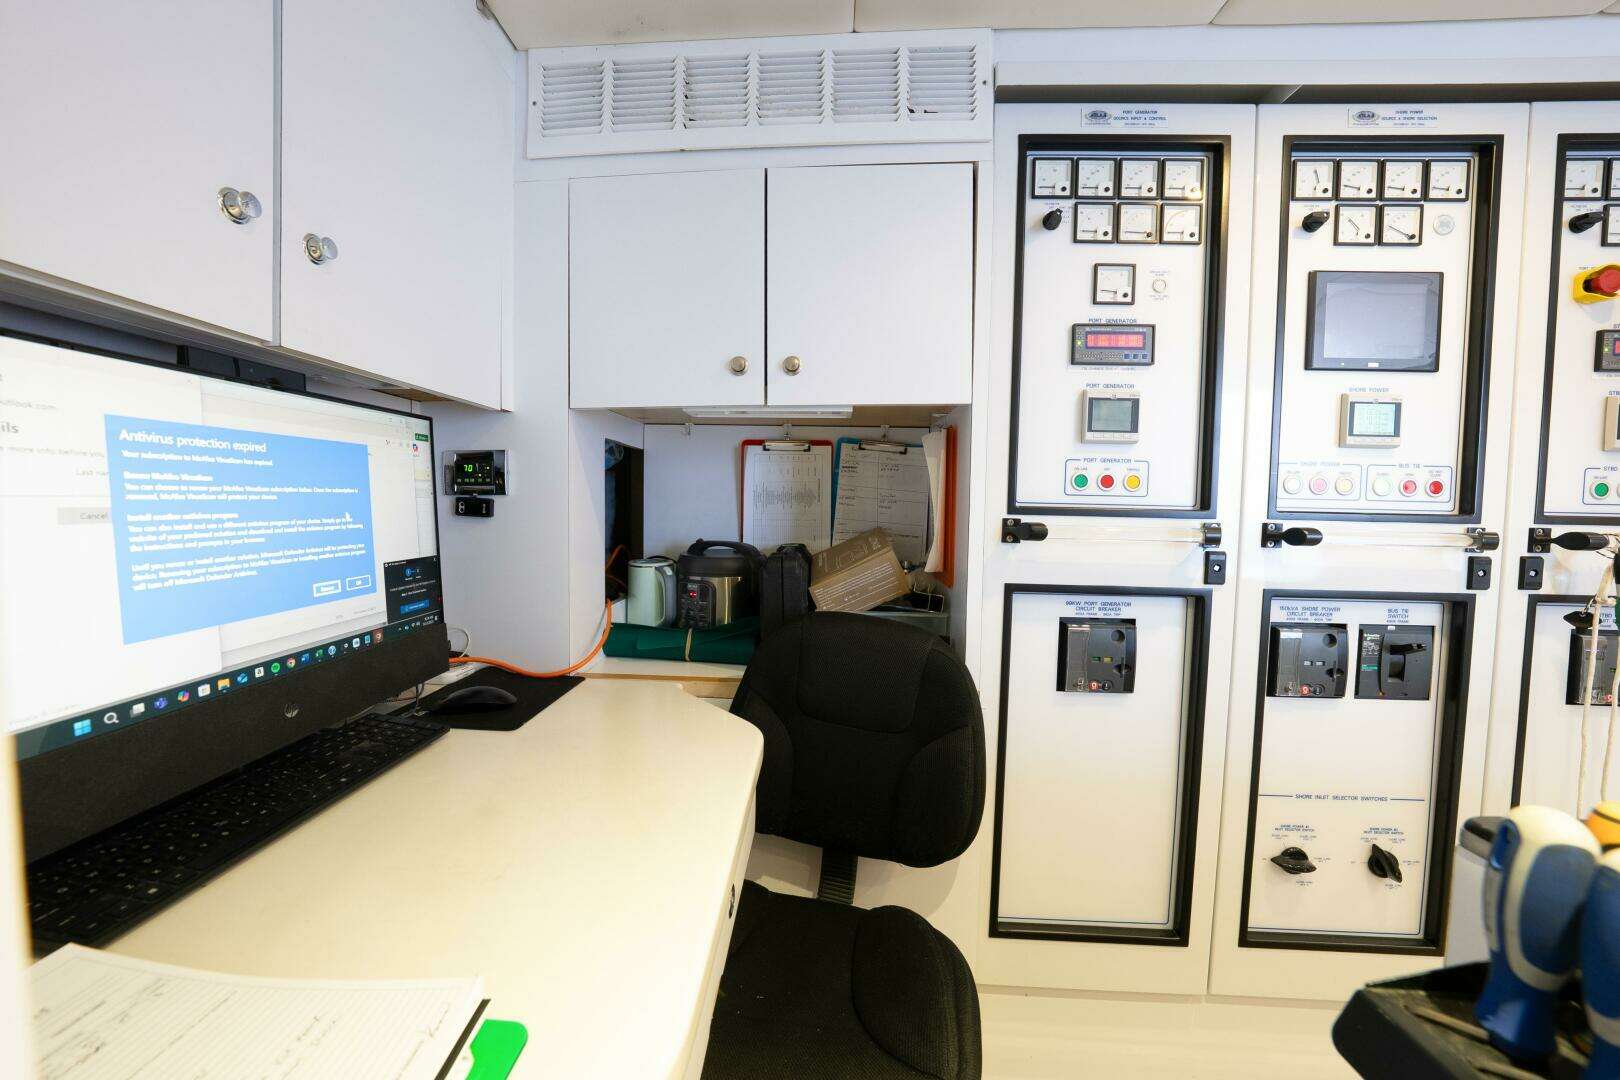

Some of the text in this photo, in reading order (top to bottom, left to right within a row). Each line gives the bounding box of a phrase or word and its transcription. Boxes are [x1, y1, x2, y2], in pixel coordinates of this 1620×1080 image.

[120, 430, 266, 452] Antivirus protection expired
